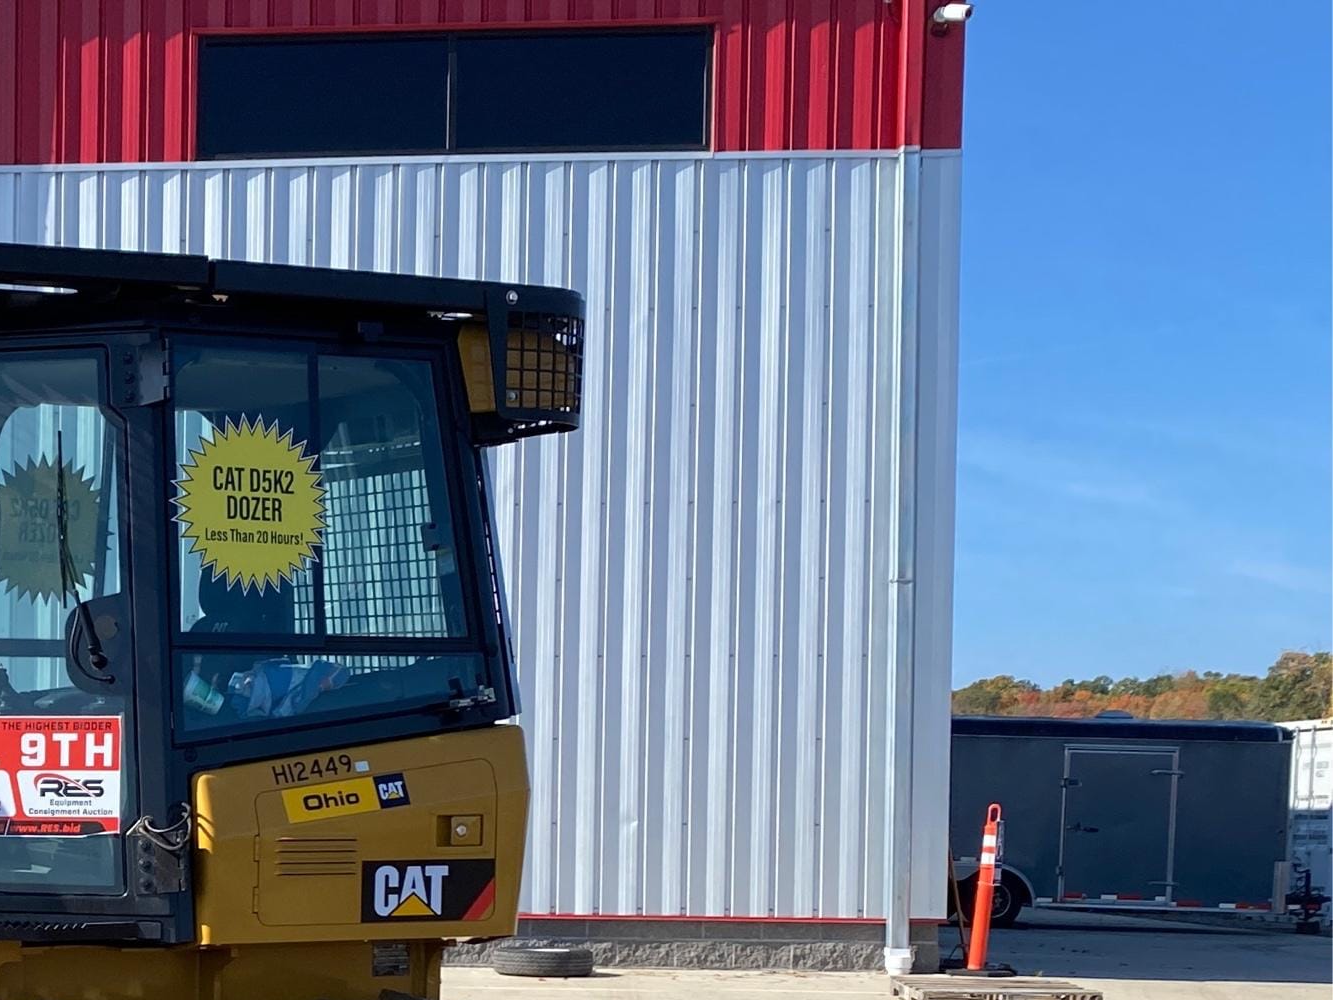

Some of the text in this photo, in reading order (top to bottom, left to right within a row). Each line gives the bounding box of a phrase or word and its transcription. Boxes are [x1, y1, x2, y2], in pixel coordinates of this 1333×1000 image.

[213, 466, 295, 495] CAT D5K2
[227, 496, 282, 522] DOZER
[205, 527, 304, 545] Less Than 20 Hours!
[2, 722, 21, 731] THE
[26, 722, 70, 731] HIGHEST
[73, 722, 112, 731] BIDDER
[21, 733, 113, 767] 9TH
[39, 779, 105, 798] RES
[378, 780, 405, 800] CAT
[49, 799, 92, 807] Equipment
[302, 790, 360, 811] Ohio
[28, 808, 113, 816] Consignment Auction
[374, 865, 450, 917] CAT
